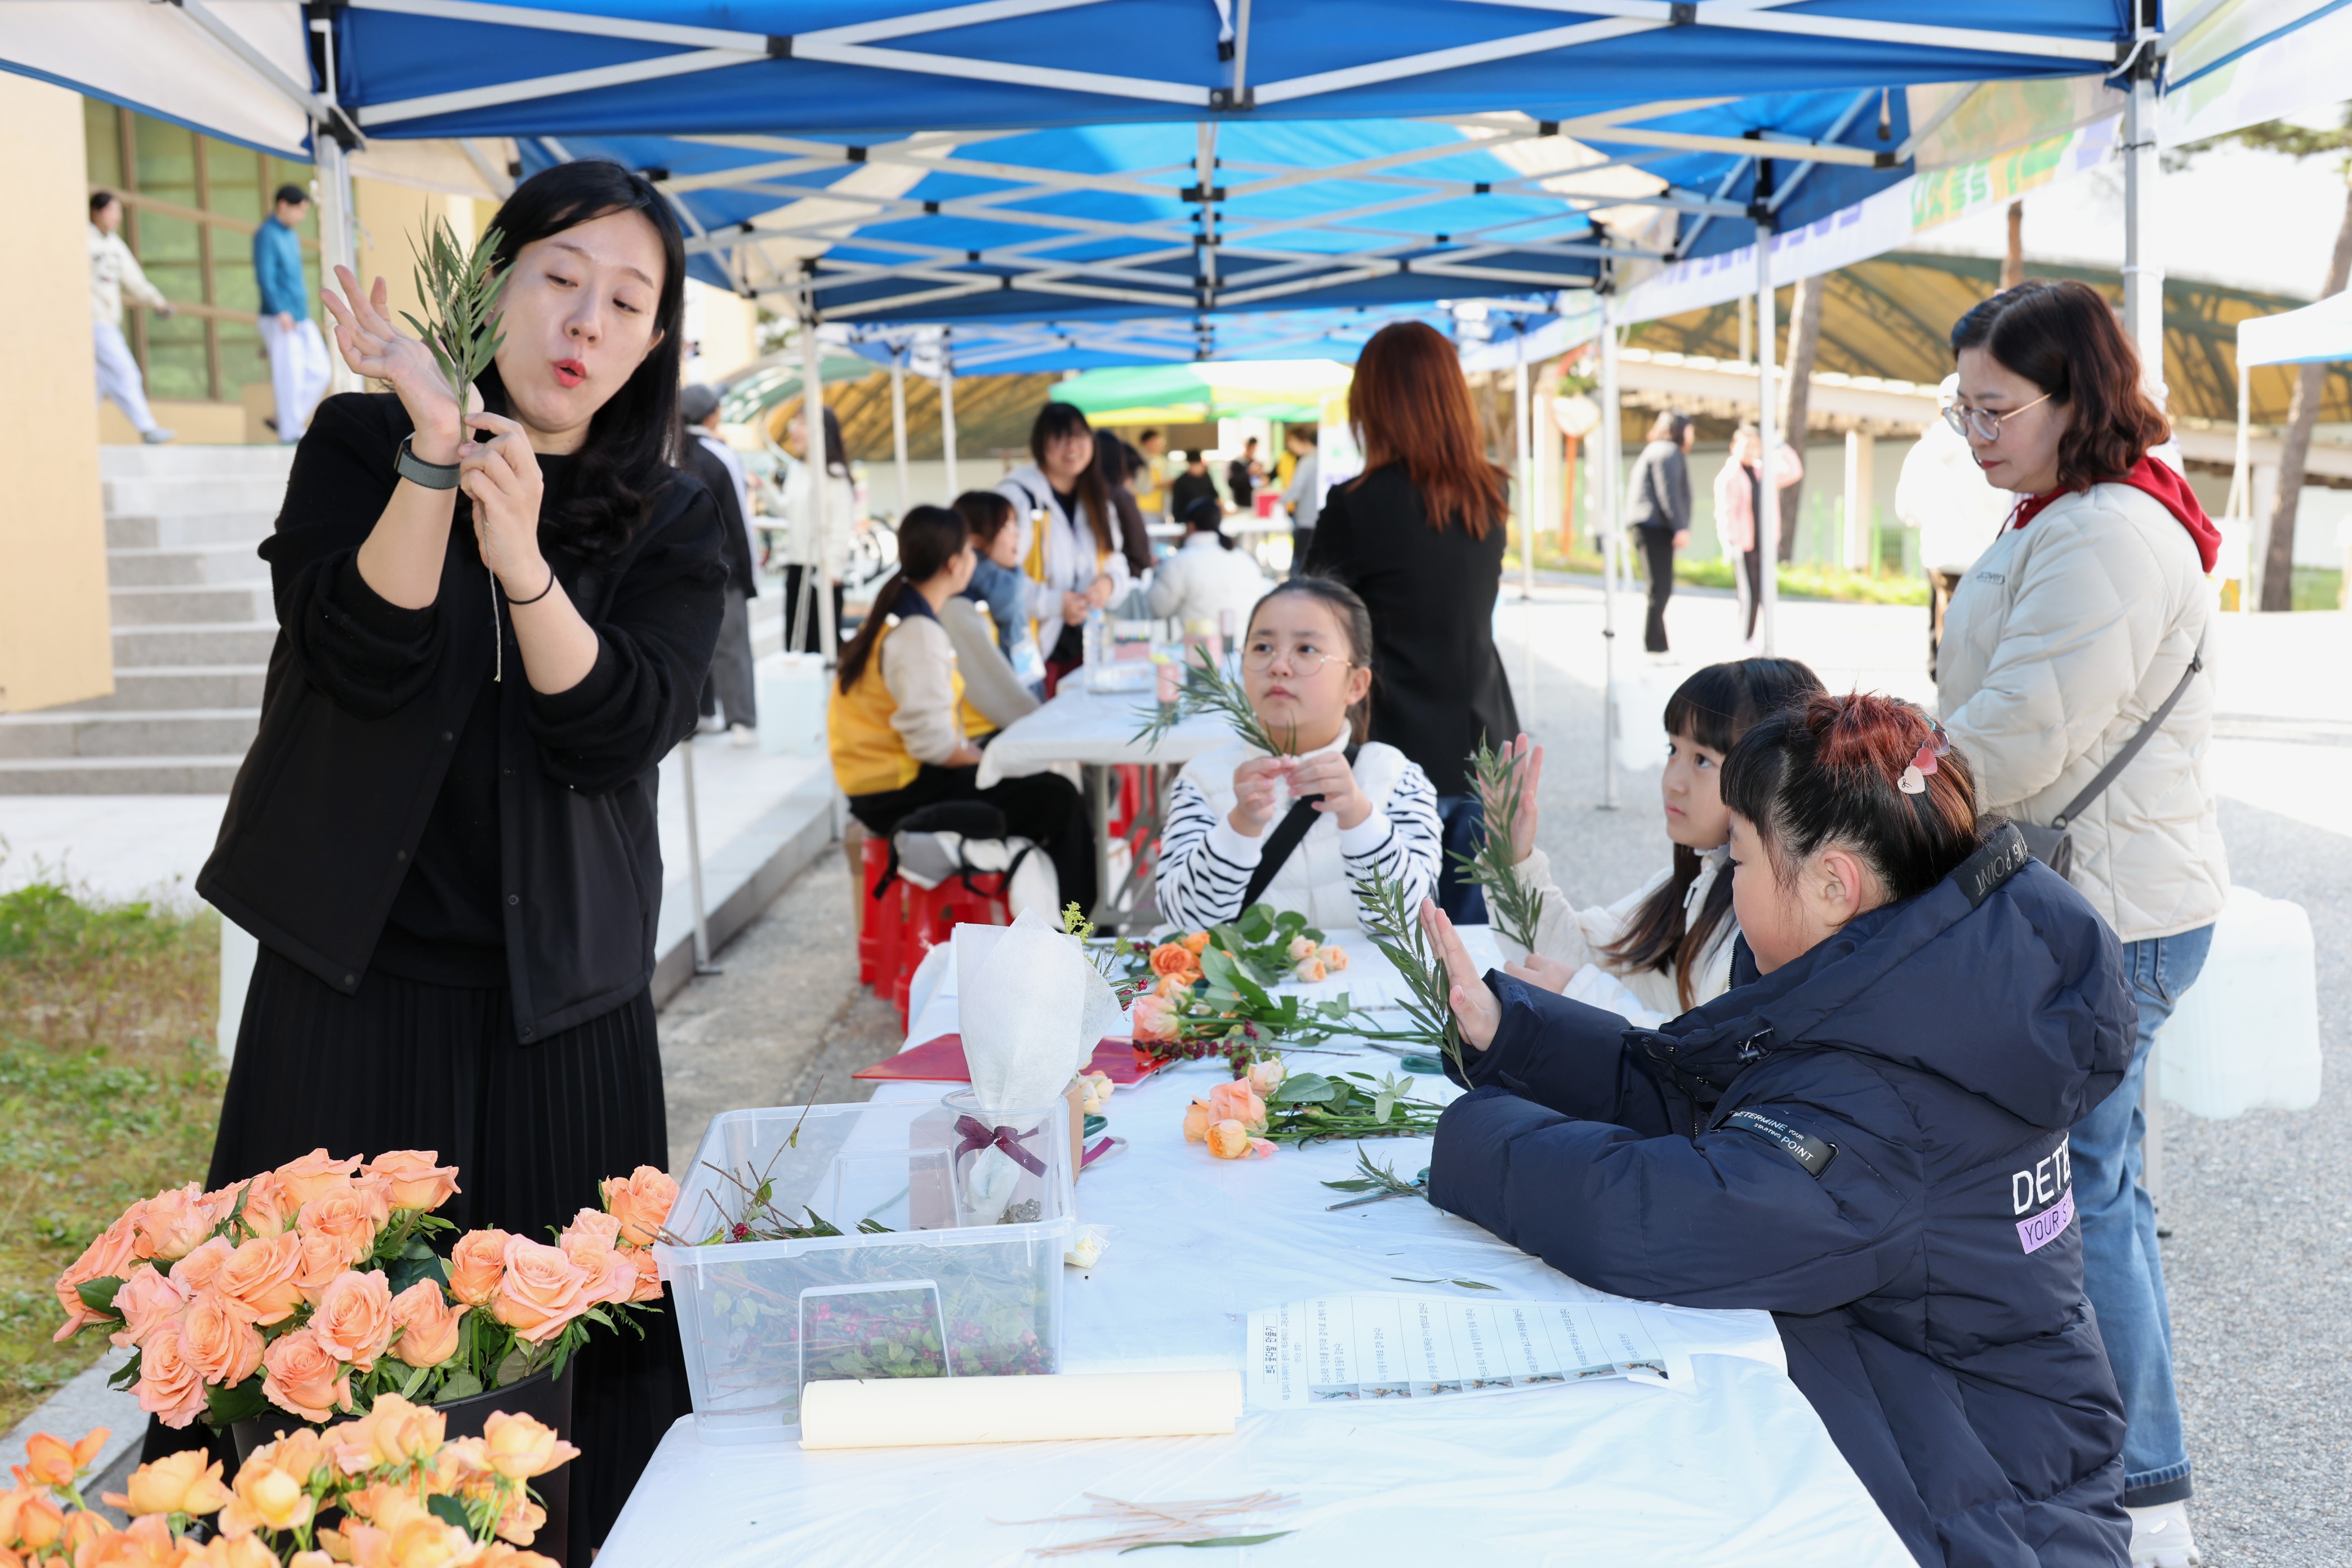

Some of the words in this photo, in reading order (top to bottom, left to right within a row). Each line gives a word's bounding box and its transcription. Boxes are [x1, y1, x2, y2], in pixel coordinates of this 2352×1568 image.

[1975, 849, 2012, 897] POINT
[1731, 1111, 1788, 1132] DETERMINE
[1788, 1128, 1805, 1141] YOUR
[1753, 1122, 1782, 1139] STARTING
[1780, 1135, 1814, 1161] POINT
[2024, 1210, 2059, 1245] YOUR
[1318, 1309, 1326, 1321] 오케이
[1265, 1326, 1276, 1343] 만들기
[1318, 1323, 1328, 1336] 검지로
[1374, 1327, 1384, 1340] 잡는다.
[1318, 1338, 1328, 1351] 엄지와
[1334, 1342, 1343, 1355] 잡는다.
[1266, 1346, 1277, 1362] 꽃다발
